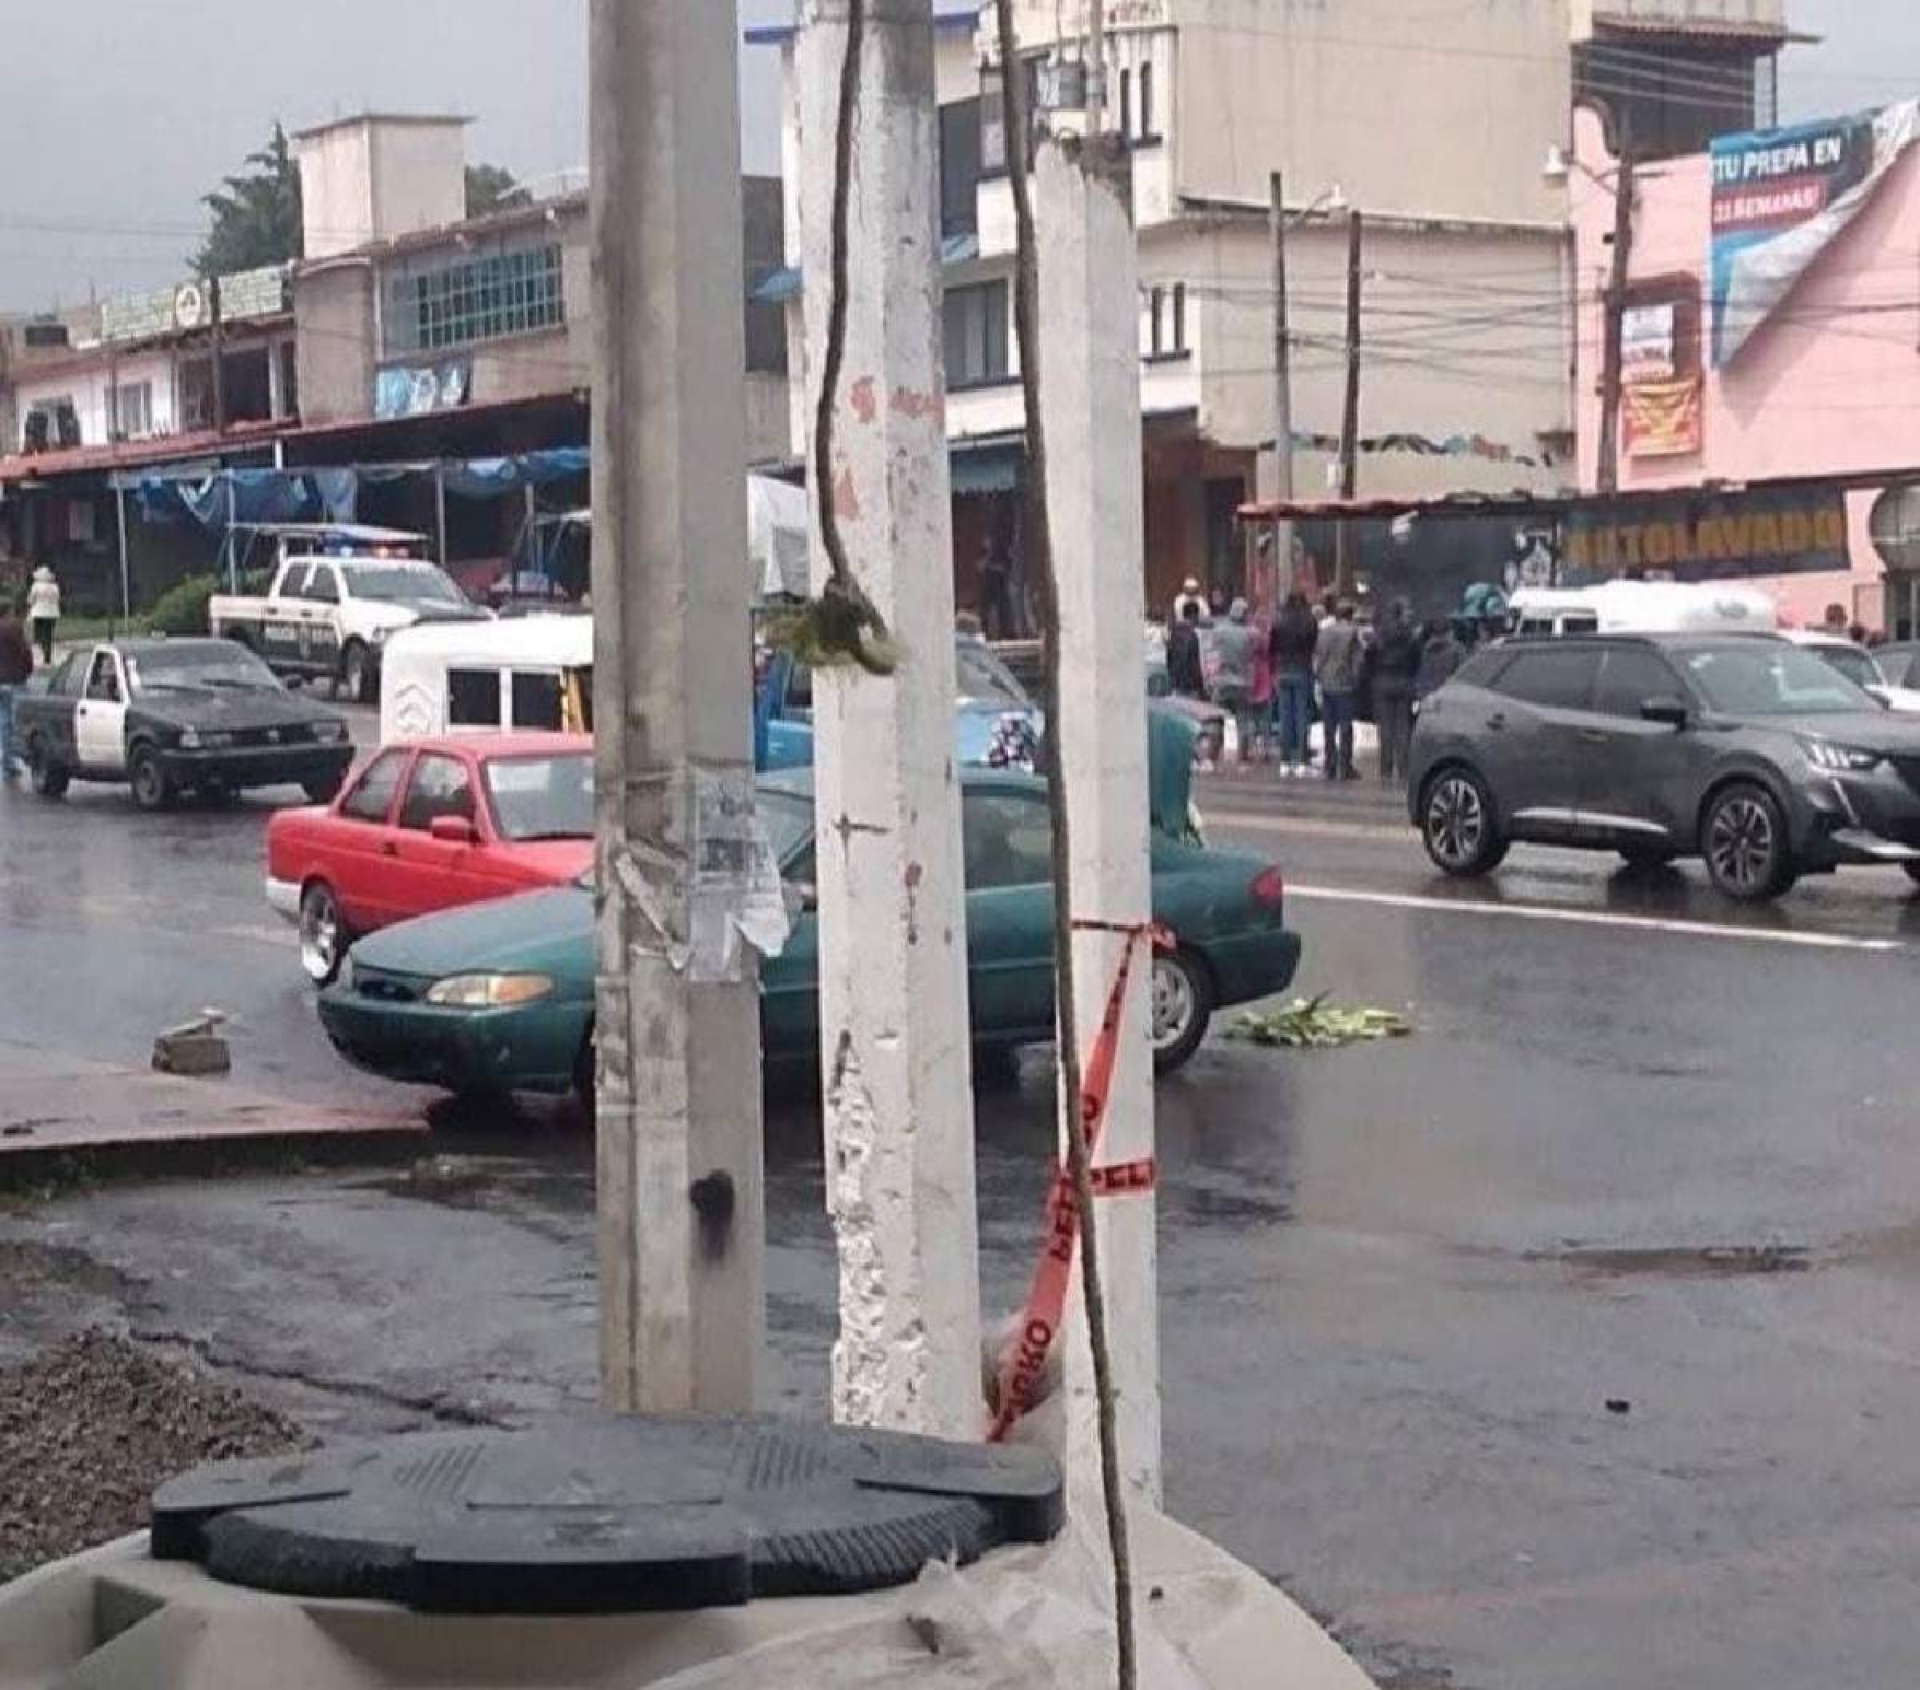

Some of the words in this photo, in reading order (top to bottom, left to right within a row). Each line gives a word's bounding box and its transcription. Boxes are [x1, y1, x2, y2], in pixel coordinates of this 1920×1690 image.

[1743, 141, 1808, 179] PREPA
[1814, 136, 1841, 165] EN
[1568, 508, 1843, 566] AUTOLAVADO
